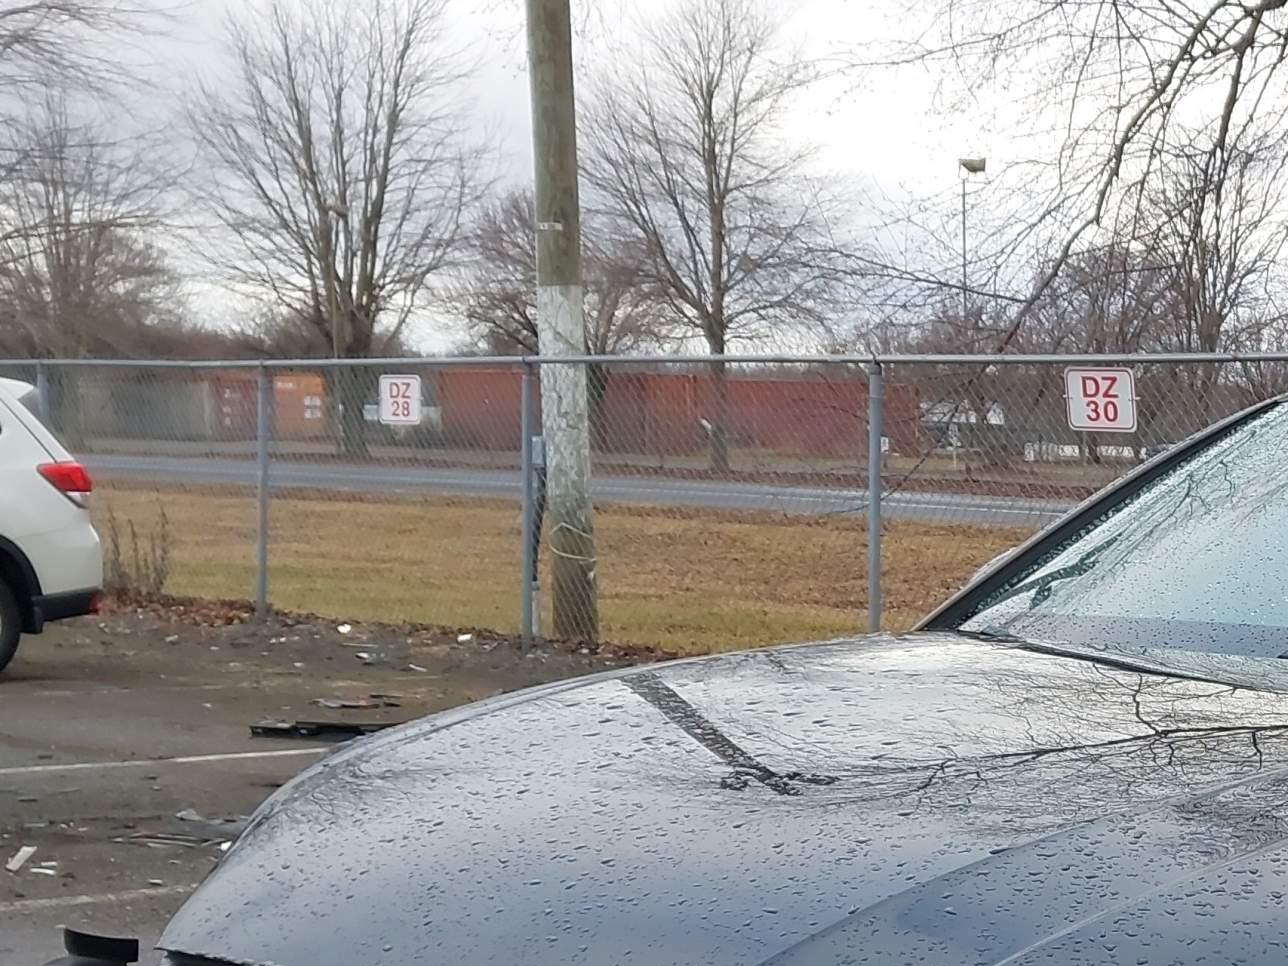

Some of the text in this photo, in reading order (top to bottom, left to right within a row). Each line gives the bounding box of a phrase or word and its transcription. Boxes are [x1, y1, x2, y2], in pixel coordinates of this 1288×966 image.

[389, 382, 411, 399] DZ
[1081, 376, 1119, 398] DZ
[391, 400, 410, 417] 28
[1086, 400, 1118, 422] 30
